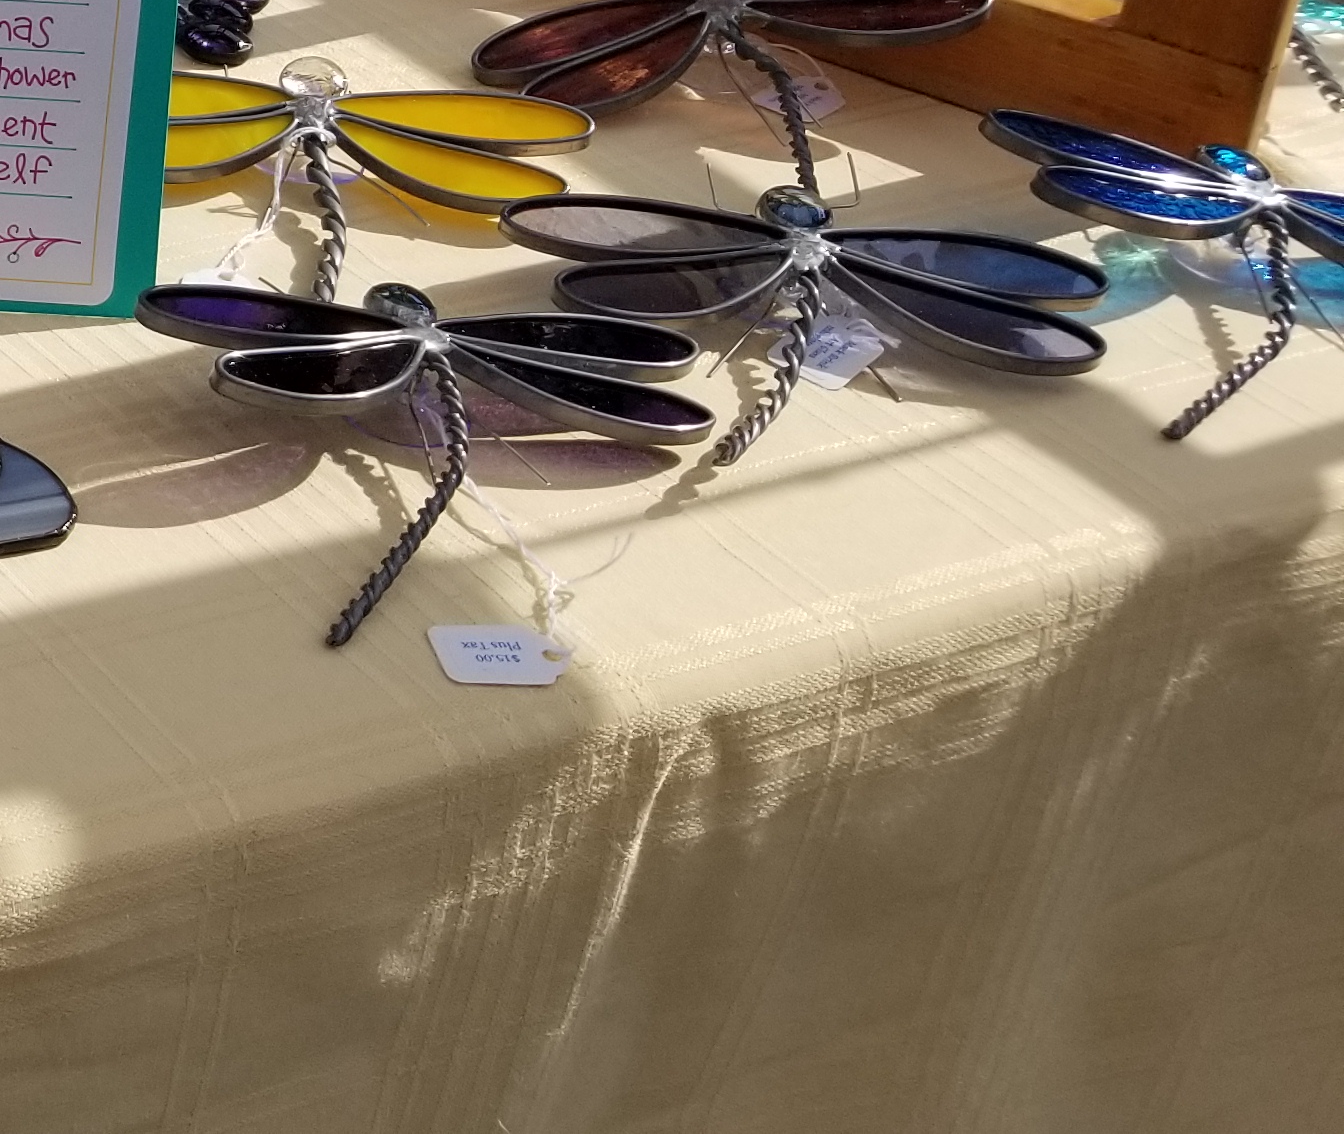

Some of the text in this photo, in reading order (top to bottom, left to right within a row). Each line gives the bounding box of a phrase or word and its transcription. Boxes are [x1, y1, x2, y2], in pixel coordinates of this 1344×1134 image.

[460, 640, 522, 652] Plus Tax
[475, 654, 522, 663] $15.00
